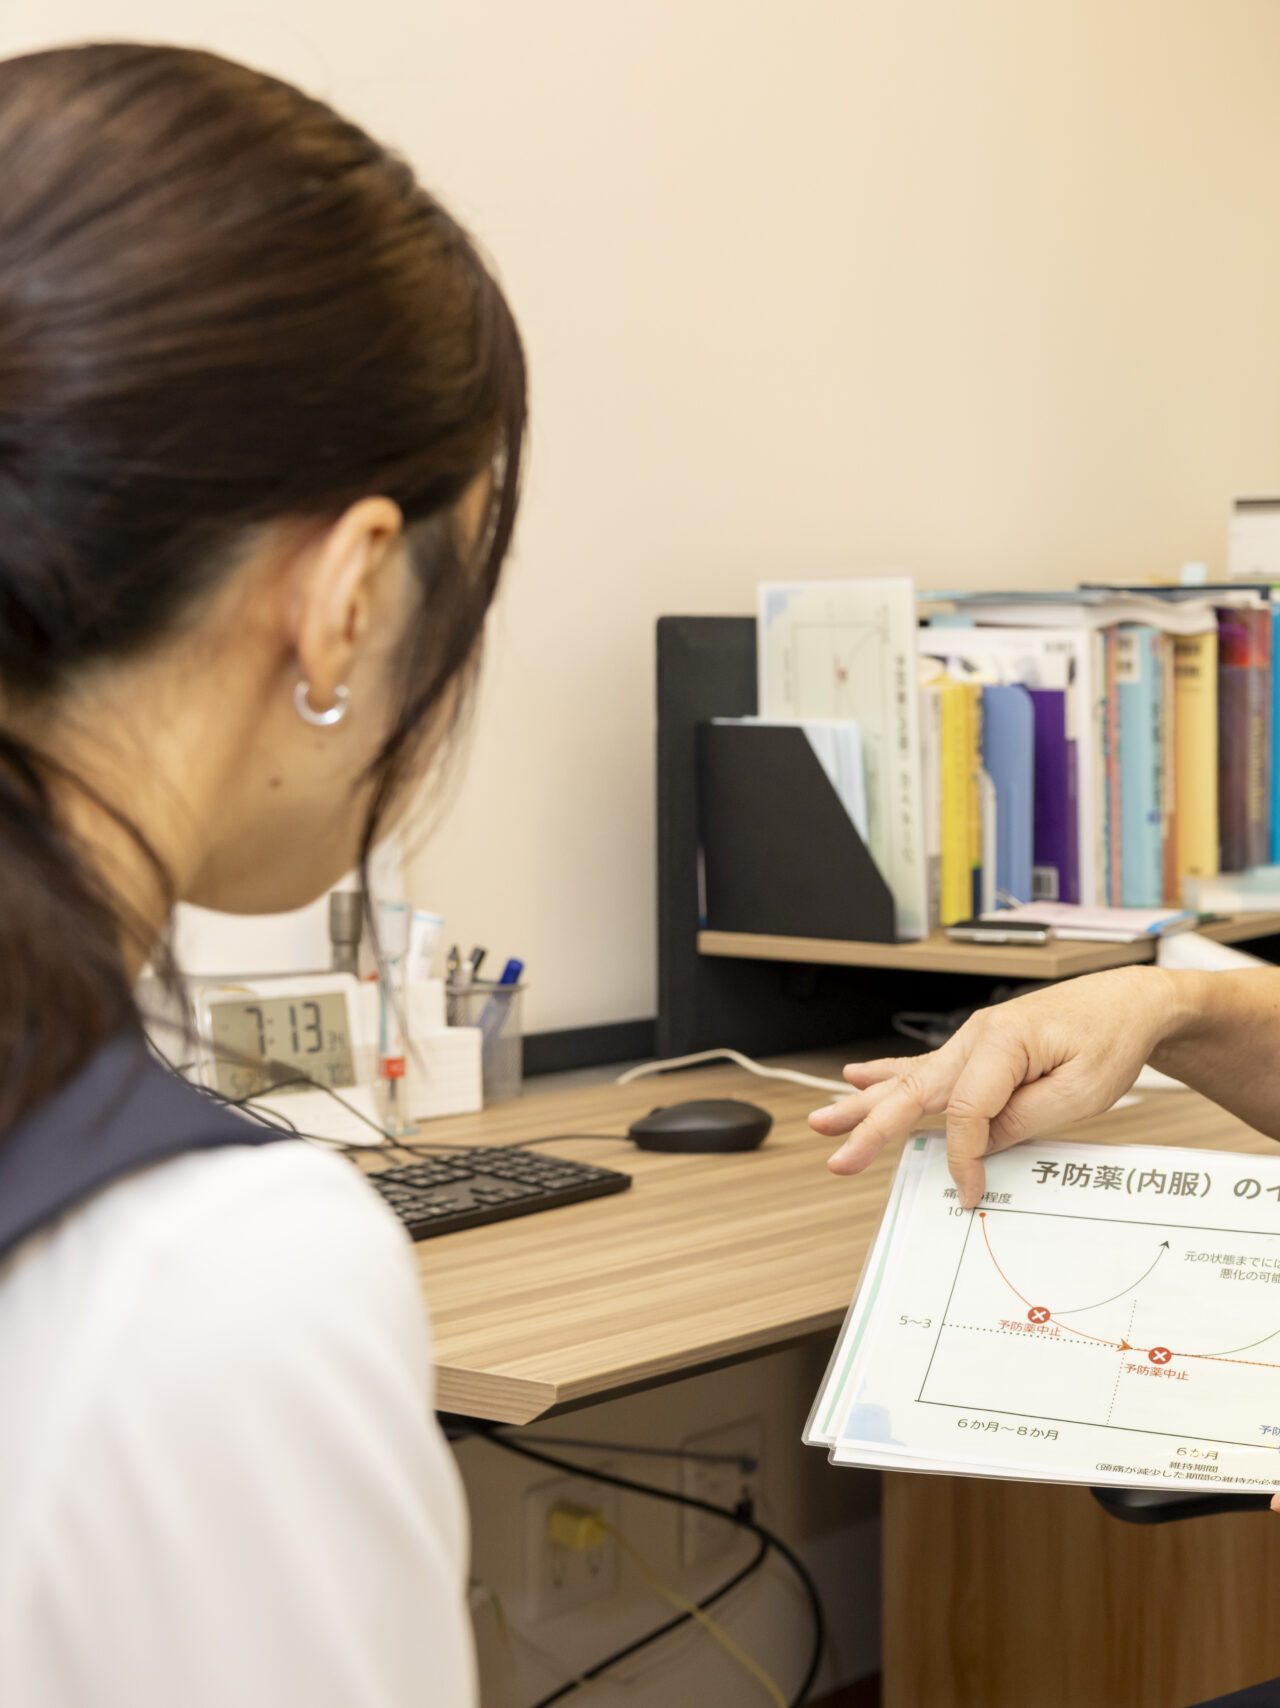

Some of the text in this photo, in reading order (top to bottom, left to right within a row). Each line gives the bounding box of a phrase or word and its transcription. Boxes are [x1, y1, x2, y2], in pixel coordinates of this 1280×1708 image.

[245, 1002, 322, 1054] 7:13
[943, 1188, 1012, 1204] 痛程度
[948, 1206, 963, 1217] 10
[997, 1319, 1062, 1337] 予防薬中止
[1123, 1363, 1190, 1381] 予防薬中止
[1169, 1461, 1219, 1473] 維持期間
